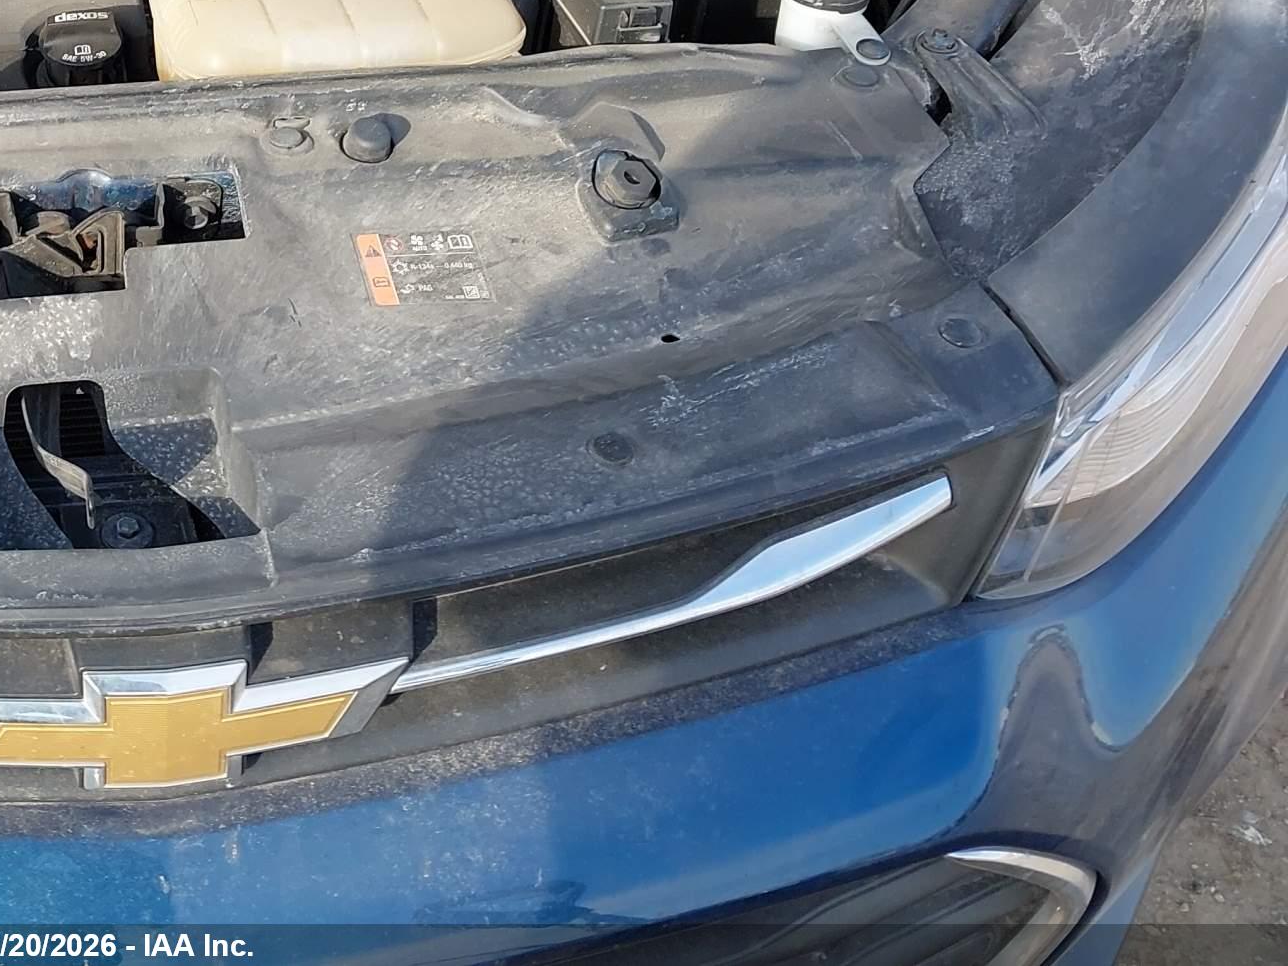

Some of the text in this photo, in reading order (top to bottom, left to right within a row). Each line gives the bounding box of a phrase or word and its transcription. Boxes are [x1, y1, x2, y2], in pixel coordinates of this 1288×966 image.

[54, 11, 109, 23] dexos
[61, 50, 107, 63] SAE 5W-30
